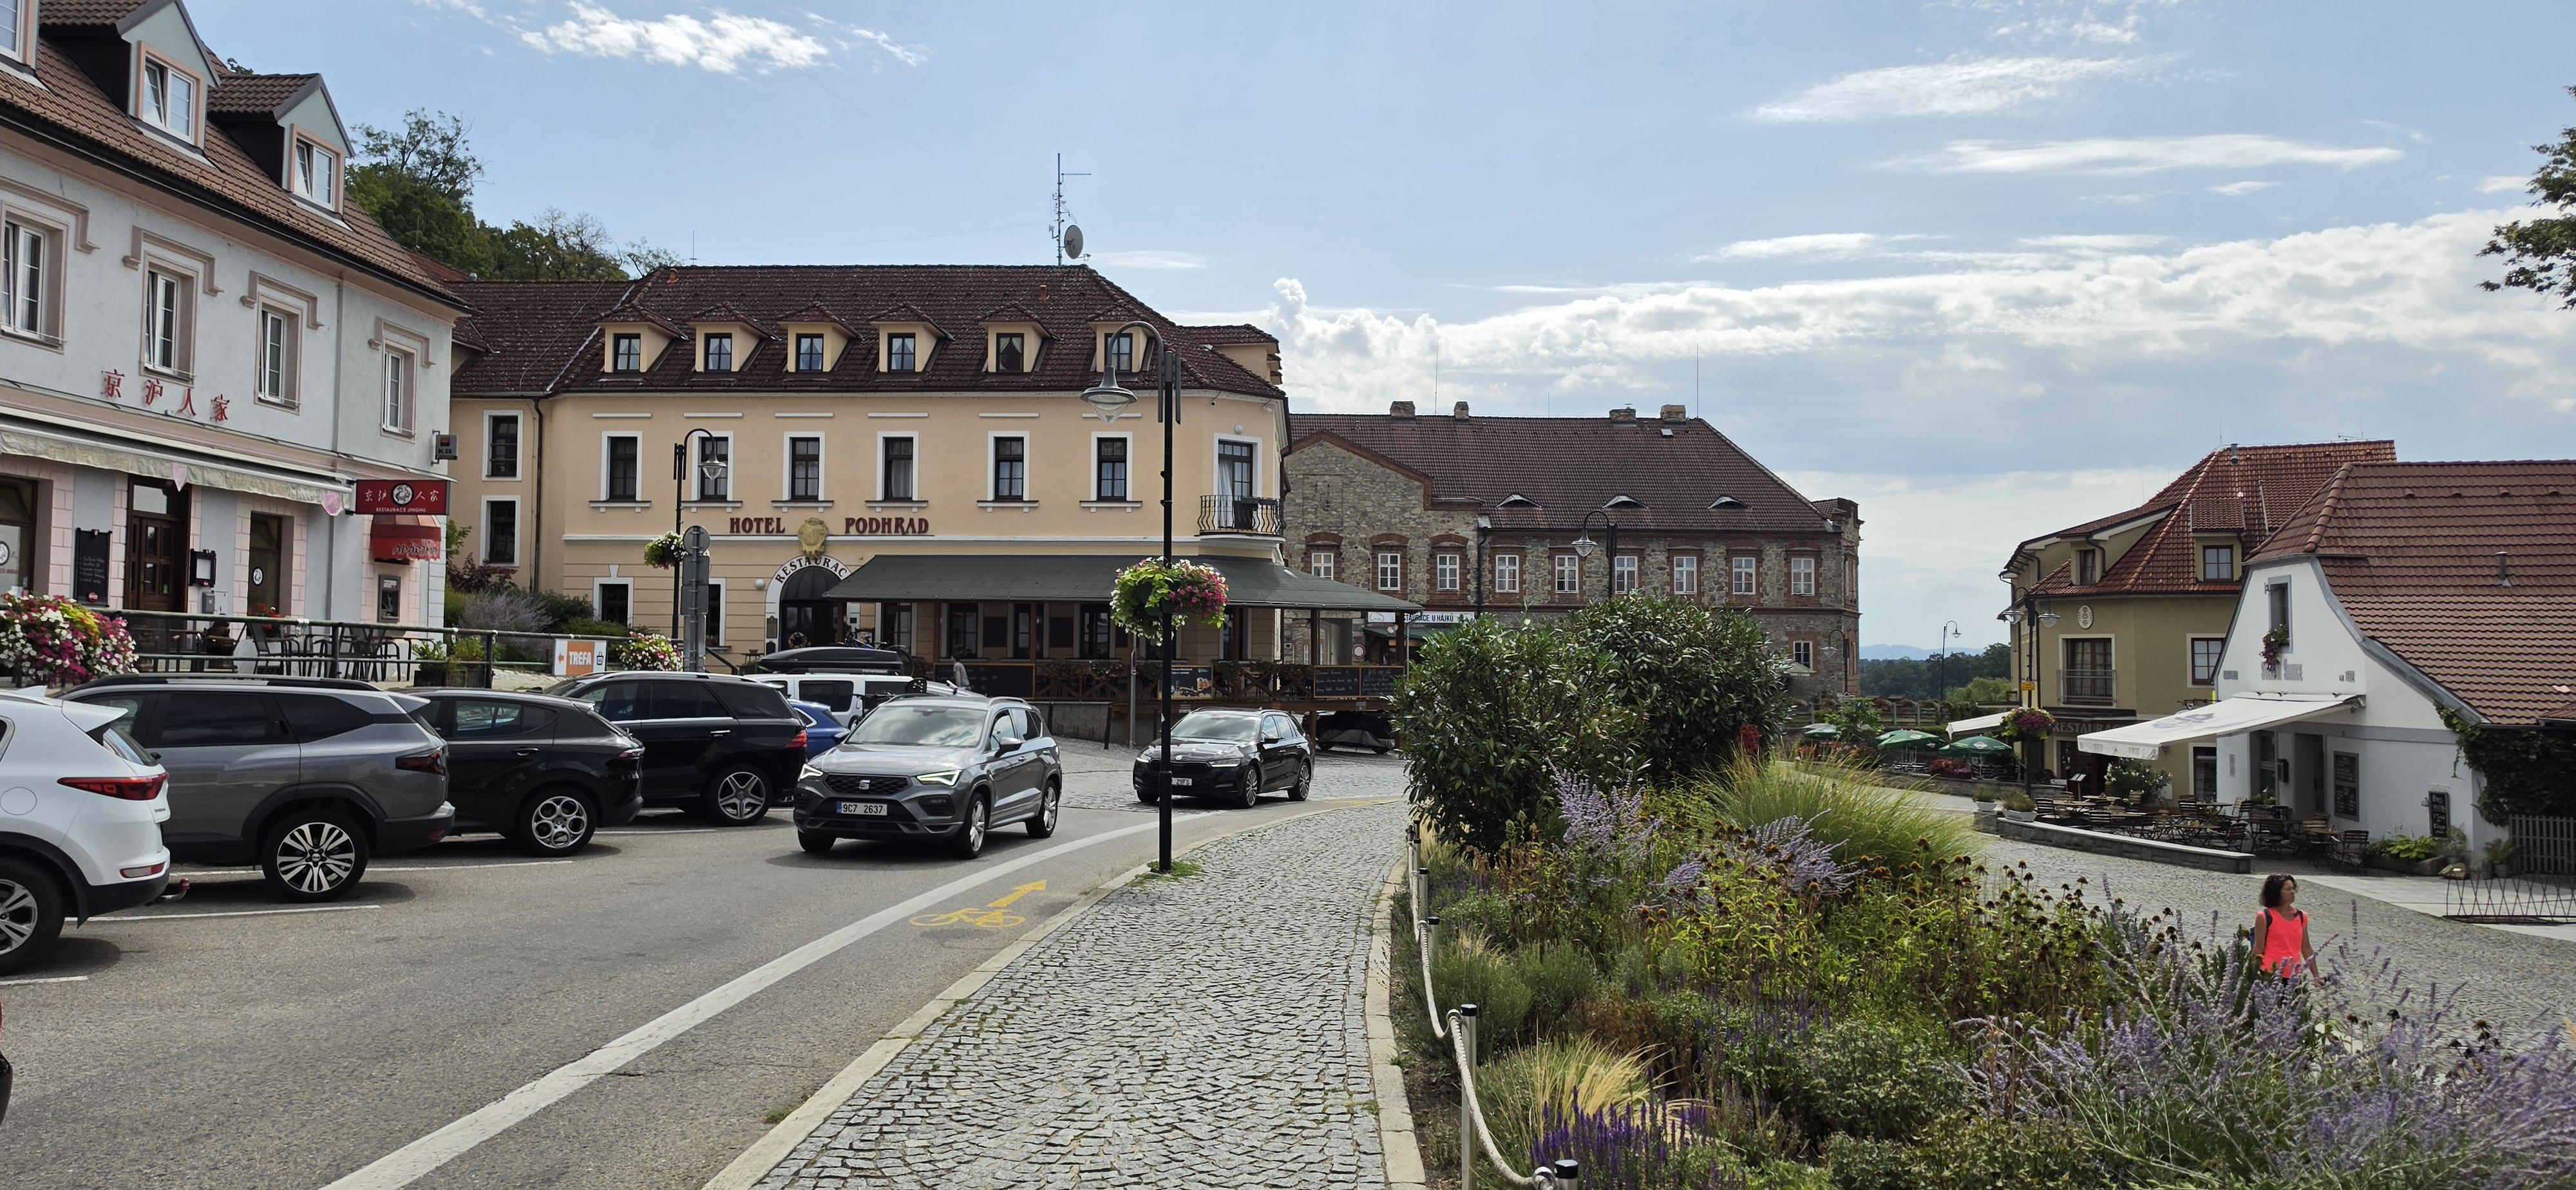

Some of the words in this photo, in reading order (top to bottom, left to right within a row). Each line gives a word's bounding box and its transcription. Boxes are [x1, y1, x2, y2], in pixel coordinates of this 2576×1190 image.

[730, 517, 786, 534] HOTEL
[844, 517, 929, 536] PODHRAD
[775, 556, 848, 583] RESTAURAC
[569, 651, 592, 665] TREFA
[843, 804, 858, 813] 9C7
[864, 804, 884, 814] 2637
